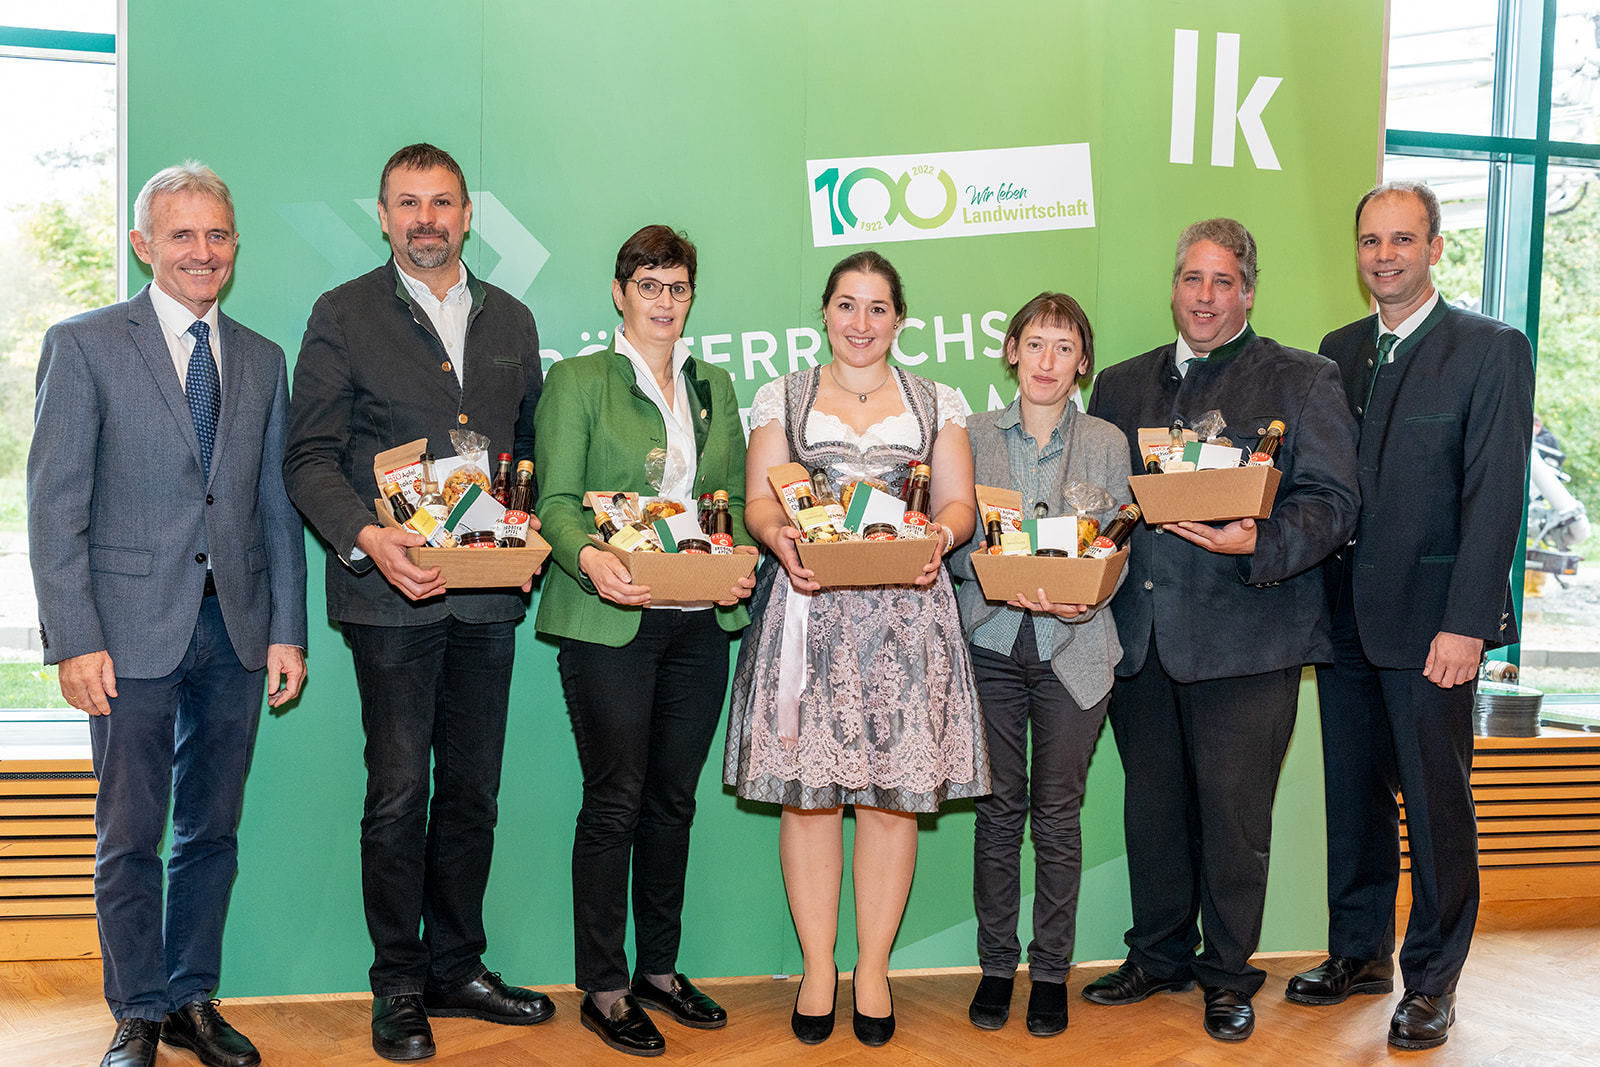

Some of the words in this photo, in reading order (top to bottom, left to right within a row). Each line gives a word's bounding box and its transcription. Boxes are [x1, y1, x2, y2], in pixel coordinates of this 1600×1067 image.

[1169, 29, 1283, 170] lk
[912, 164, 935, 176] 2022
[814, 166, 957, 236] 100
[965, 185, 995, 205] Wir
[996, 182, 1028, 204] leben
[962, 199, 1089, 224] Landwirtschaft
[860, 220, 884, 231] 1922
[576, 310, 1008, 384] ERRCHS
